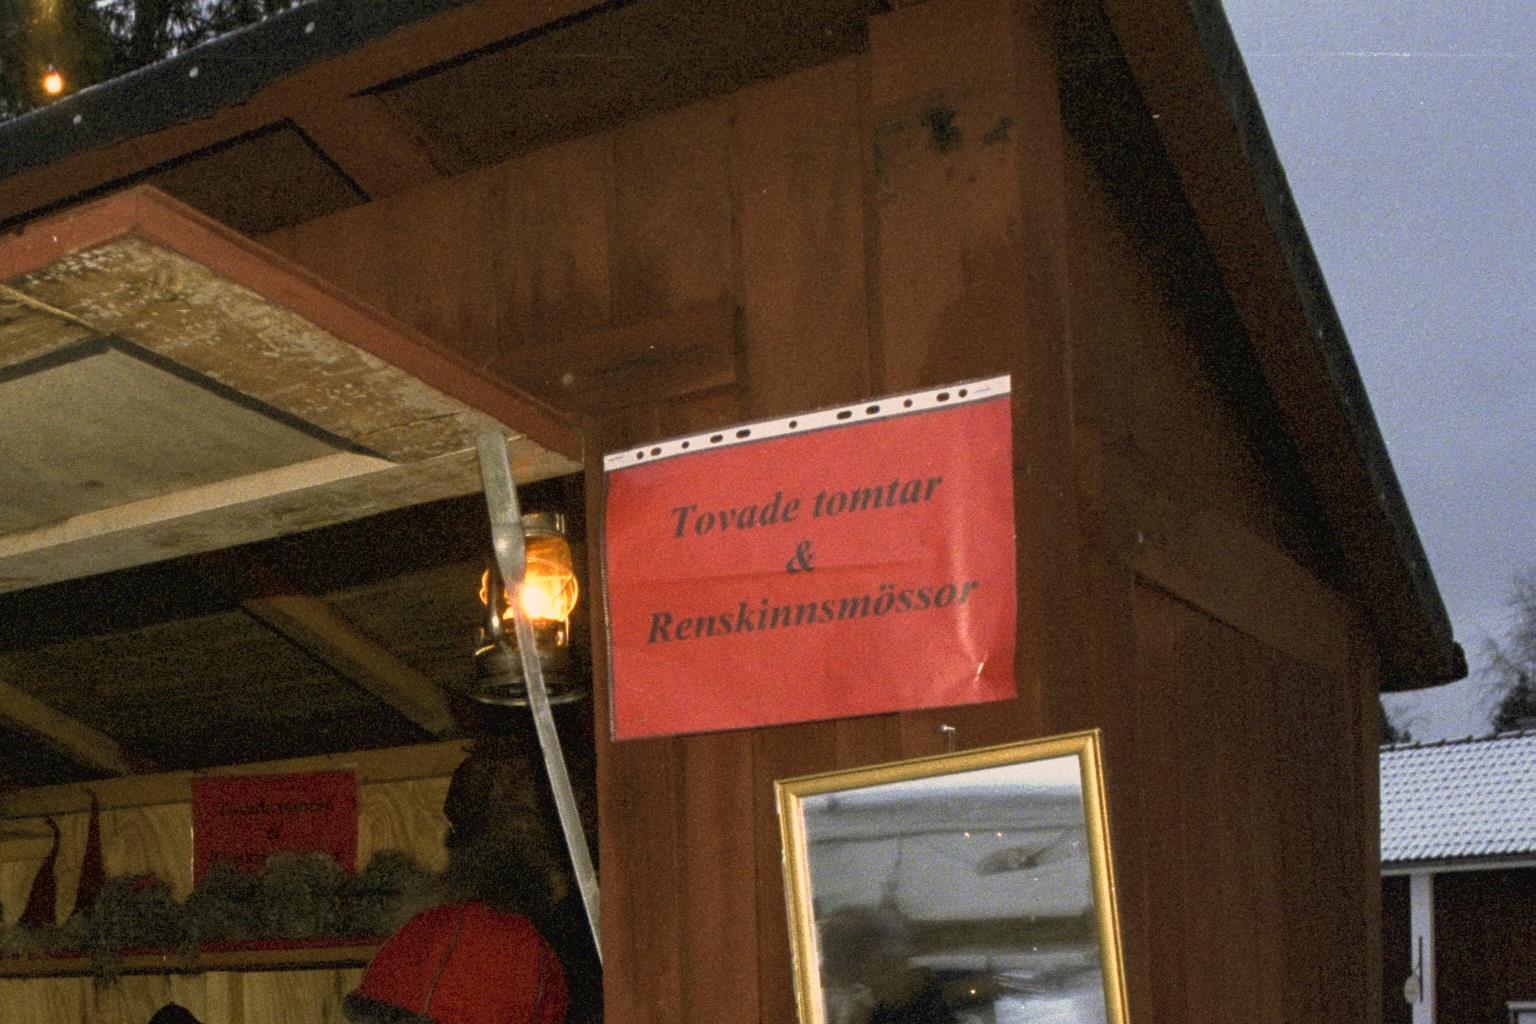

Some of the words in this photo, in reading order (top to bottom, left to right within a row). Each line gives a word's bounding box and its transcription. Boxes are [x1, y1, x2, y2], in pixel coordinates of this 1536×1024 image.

[672, 488, 800, 540] Tovade
[812, 474, 944, 518] tomtar
[785, 538, 815, 574] &
[648, 580, 979, 645] Renskinnsmössor
